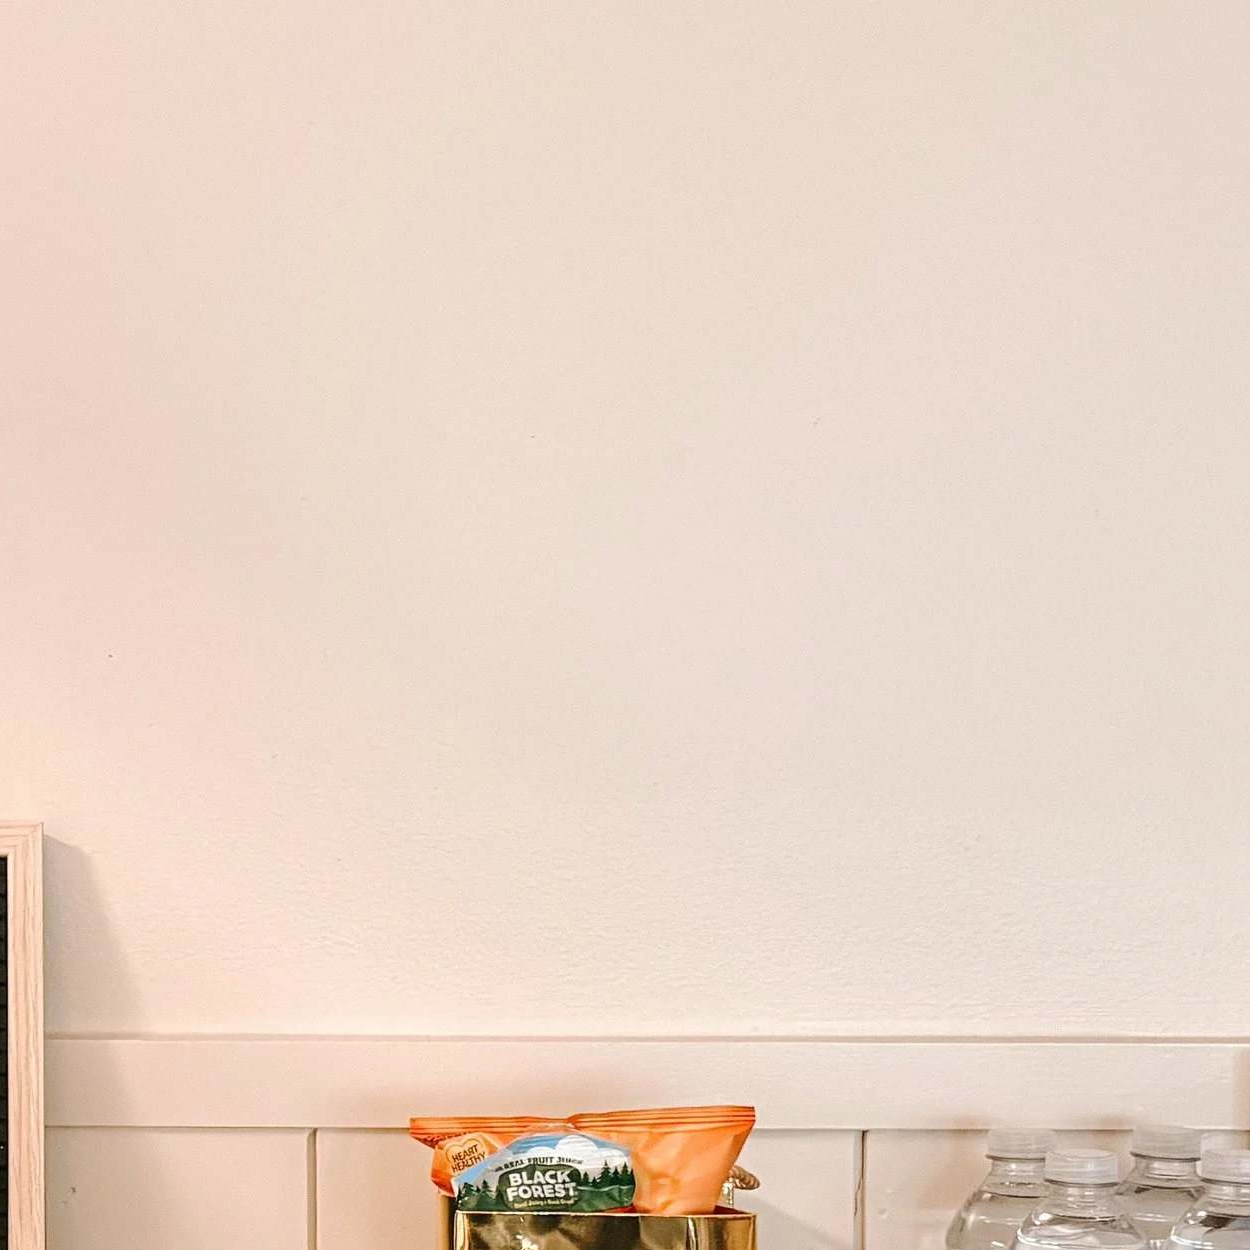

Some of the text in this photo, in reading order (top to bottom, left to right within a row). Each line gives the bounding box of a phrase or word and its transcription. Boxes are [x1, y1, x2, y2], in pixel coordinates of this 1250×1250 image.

[451, 1151, 486, 1173] HEALTHY
[452, 1144, 478, 1163] HEART
[508, 1169, 571, 1185] BLACK
[506, 1183, 577, 1202] FOREST
